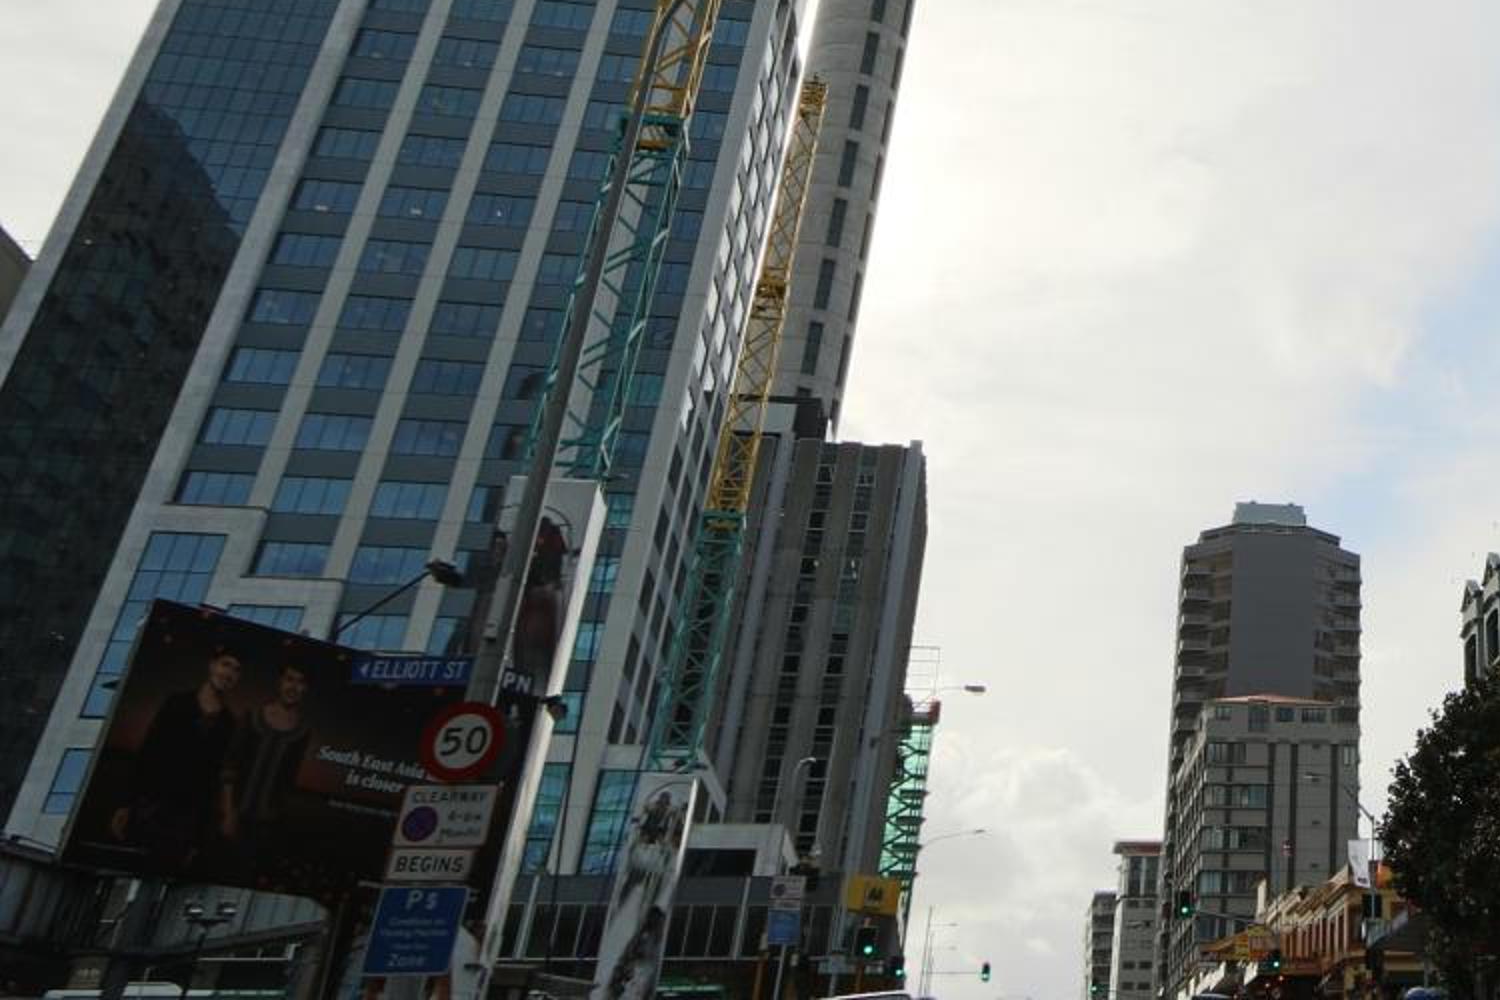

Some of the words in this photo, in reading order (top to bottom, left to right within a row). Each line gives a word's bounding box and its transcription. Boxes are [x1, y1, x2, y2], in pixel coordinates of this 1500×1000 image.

[371, 660, 436, 680] ELLIOTT
[444, 660, 468, 679] ST
[441, 726, 487, 756] 50
[394, 855, 464, 873] BEGINS
